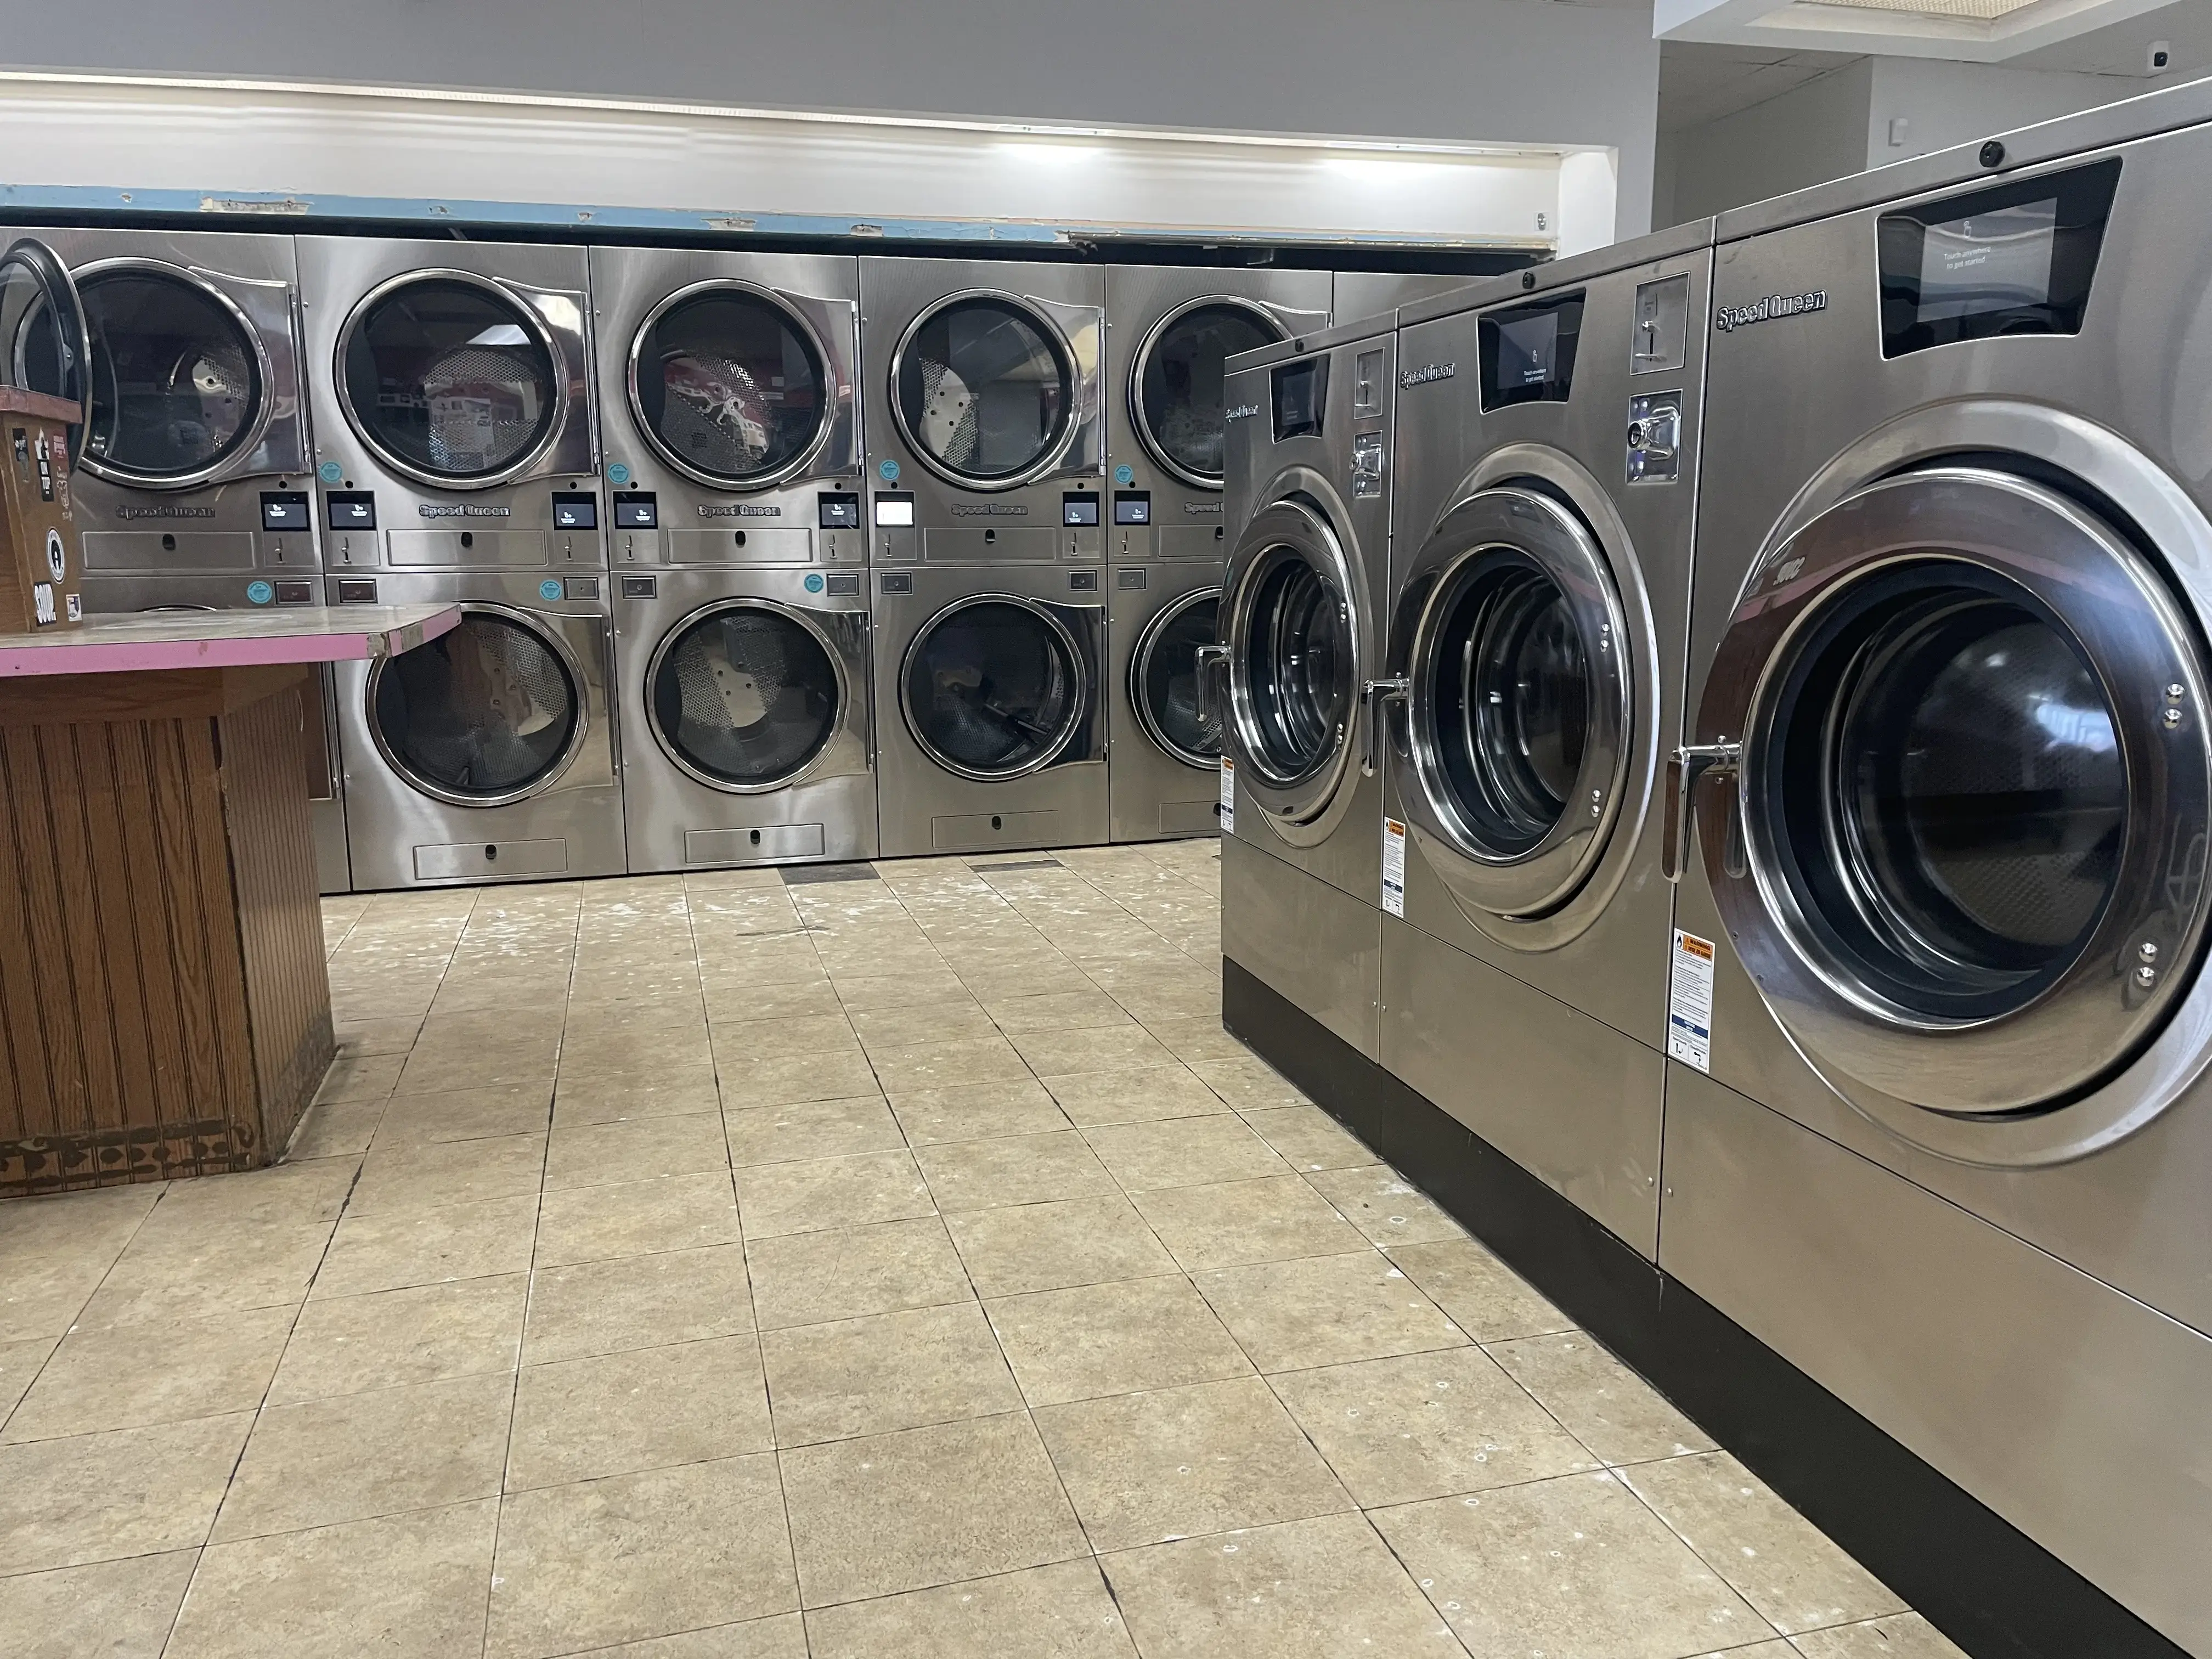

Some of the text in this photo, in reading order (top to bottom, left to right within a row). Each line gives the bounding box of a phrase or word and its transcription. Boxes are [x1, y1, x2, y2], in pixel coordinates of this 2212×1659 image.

[1962, 246, 1991, 257] anywhere
[1954, 261, 1963, 269] get
[1965, 256, 1985, 266] started
[1717, 290, 1828, 332] Speed Queen
[1400, 363, 1455, 390] Speed Queen
[419, 504, 511, 518] Speed Queen
[697, 504, 781, 518] Speed Queen
[951, 504, 1028, 517] Speed Queen
[1184, 501, 1220, 515] Speed
